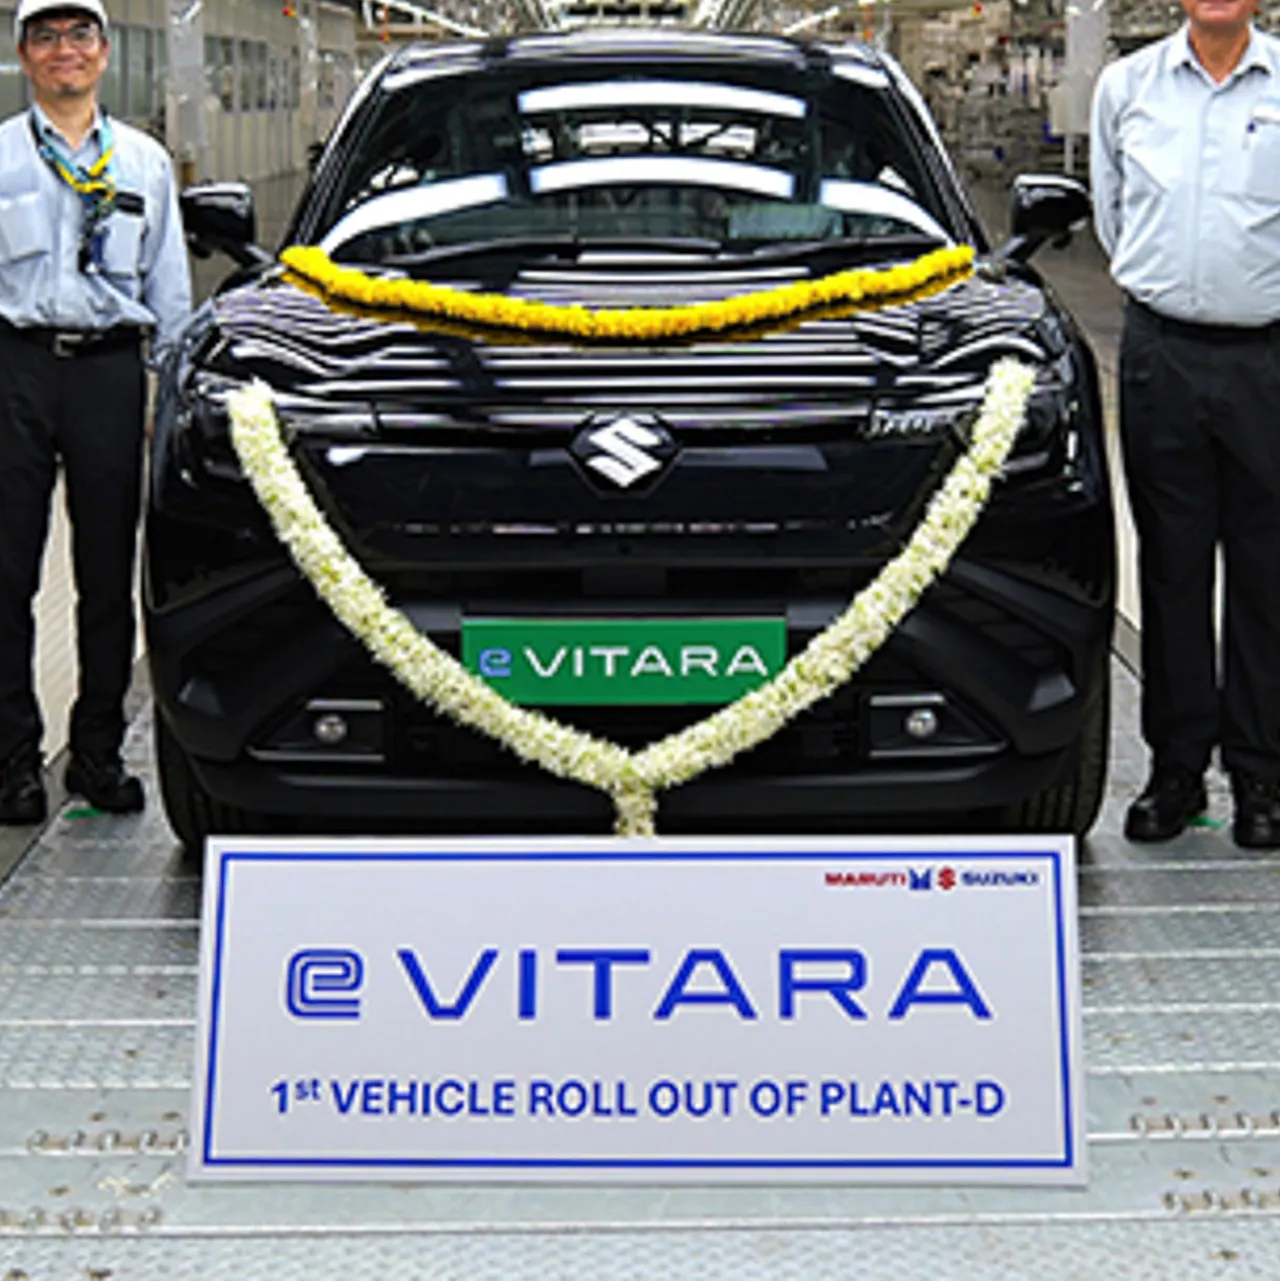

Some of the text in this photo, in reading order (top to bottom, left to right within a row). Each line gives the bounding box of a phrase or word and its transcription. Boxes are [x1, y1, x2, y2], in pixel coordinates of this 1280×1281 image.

[480, 645, 769, 677] e VITARA
[824, 871, 1039, 886] MARUTI SUZUKI
[285, 948, 992, 1021] e VITARA
[271, 1078, 1006, 1118] 1st VEHICLE ROLL OUT OF PLANT-D
